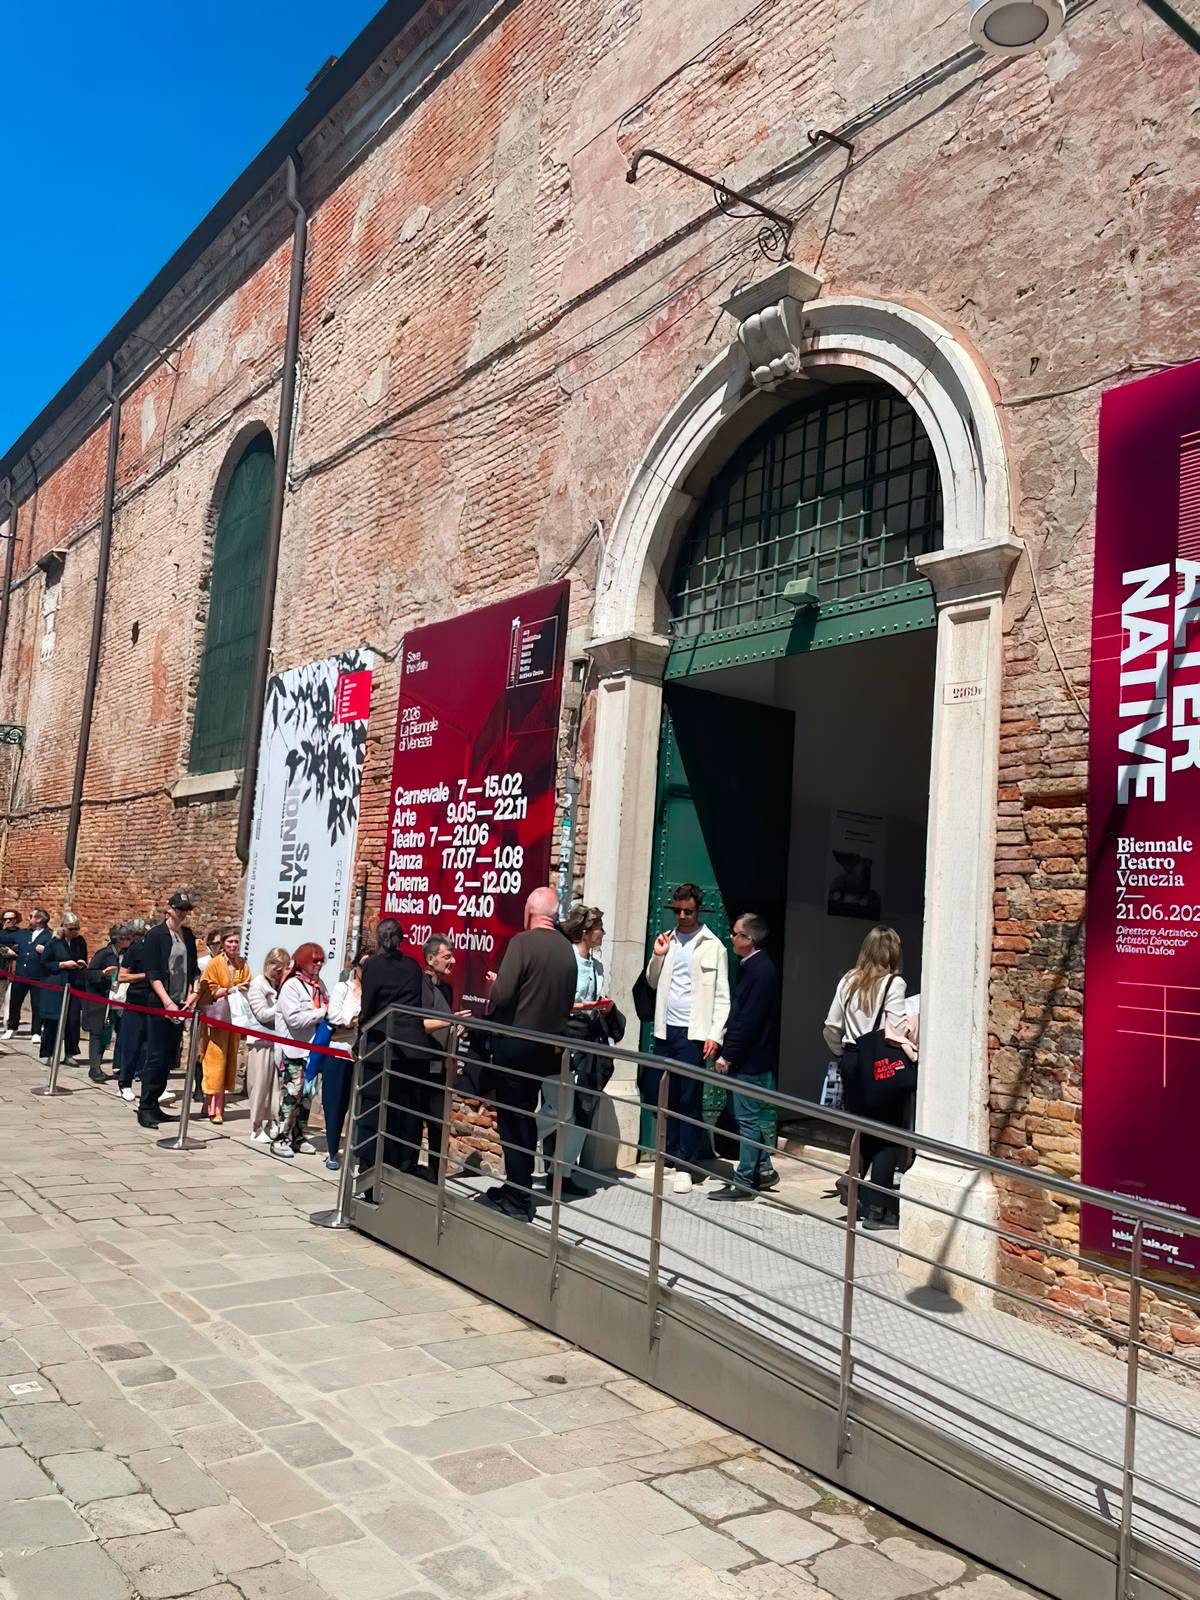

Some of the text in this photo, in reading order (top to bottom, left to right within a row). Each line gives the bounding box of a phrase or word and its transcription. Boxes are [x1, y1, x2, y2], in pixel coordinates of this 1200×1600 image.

[1117, 563, 1170, 805] NATIVE
[394, 782, 450, 806] Carnevale
[392, 808, 417, 827] Arte
[391, 828, 425, 848] Teatro
[1116, 836, 1193, 853] Biennale
[388, 850, 423, 870] Danza
[1116, 854, 1175, 870] Teatro
[289, 842, 310, 926] KEYS
[387, 871, 429, 892] Cinema
[1116, 870, 1185, 887] Venezia
[275, 891, 291, 925] IN
[384, 892, 424, 914] Musica
[447, 927, 494, 952] Archivio
[1147, 945, 1175, 956] Dafoe
[1112, 1229, 1179, 1255] labienale.org
